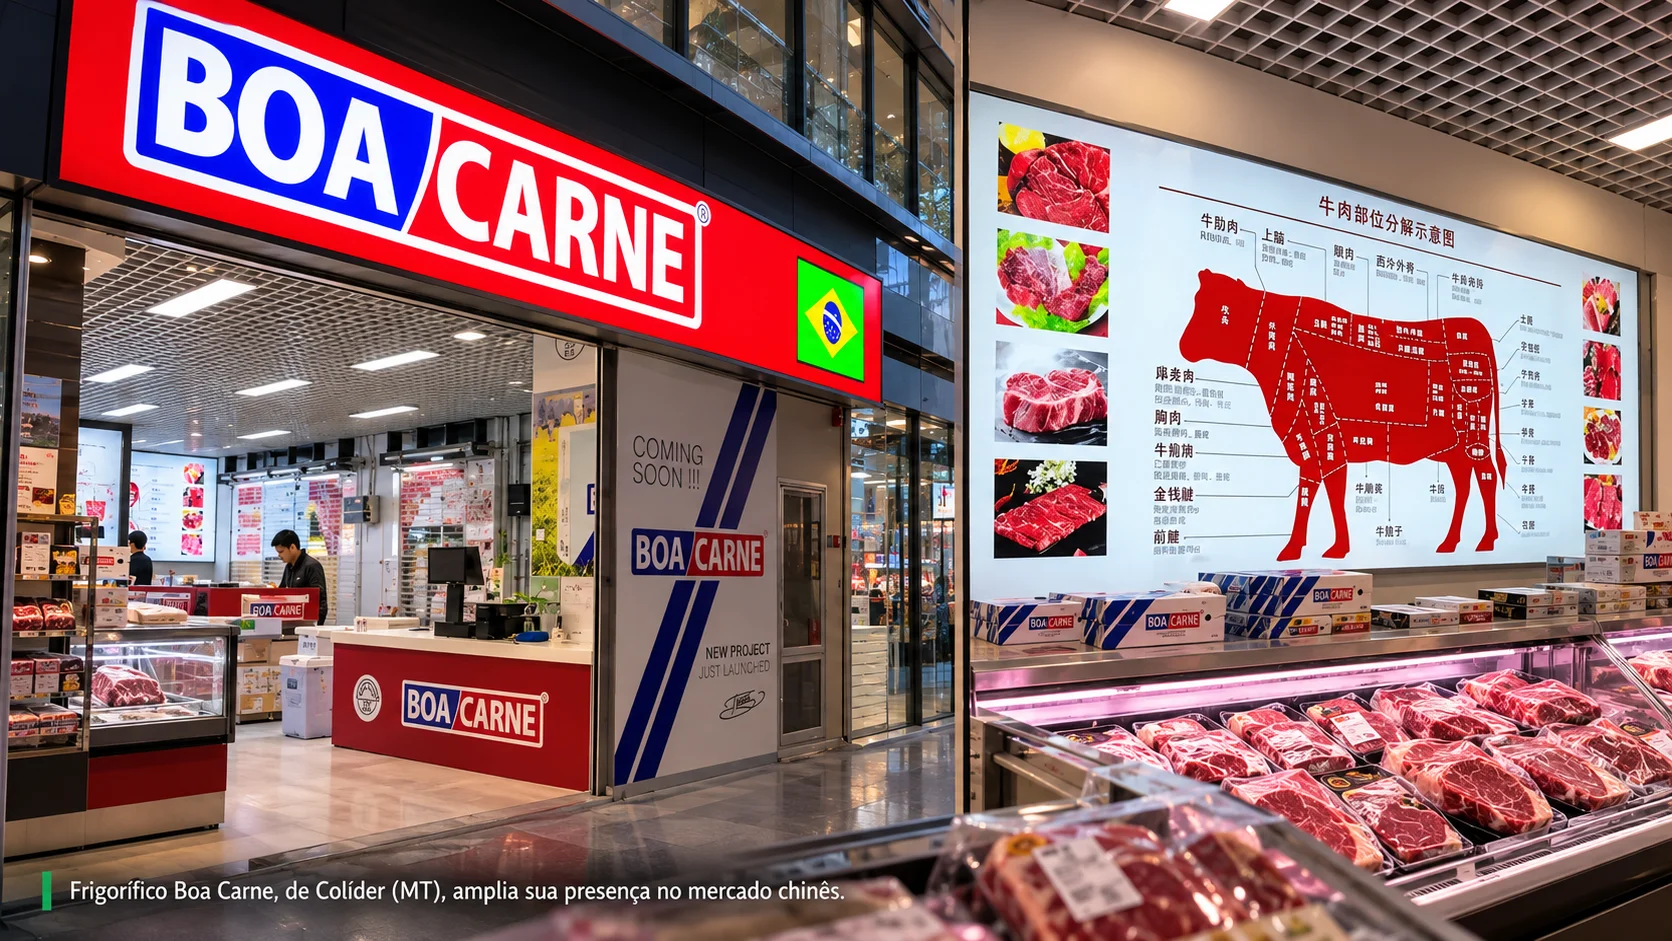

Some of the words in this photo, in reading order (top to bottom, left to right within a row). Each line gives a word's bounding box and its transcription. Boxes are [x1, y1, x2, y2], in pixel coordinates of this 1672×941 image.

[155, 27, 399, 217] BOA
[437, 140, 684, 304] CARNE
[1318, 195, 1455, 249] 牛肉部位分解示意图
[633, 435, 703, 466] COMING
[633, 462, 683, 488] SOON
[688, 468, 701, 490] !!!
[636, 535, 685, 570] BOA
[695, 538, 762, 572] CARNE
[1314, 591, 1330, 601] BOA
[1030, 617, 1047, 628] BOA
[1148, 616, 1168, 628] BOA
[1170, 613, 1200, 627] CARNE
[706, 646, 728, 660] NEW
[730, 642, 771, 657] PROJECT
[698, 664, 721, 680] JUST
[723, 660, 771, 676] LAUNCHED
[407, 688, 451, 724] BOA
[460, 696, 536, 737] CARNE
